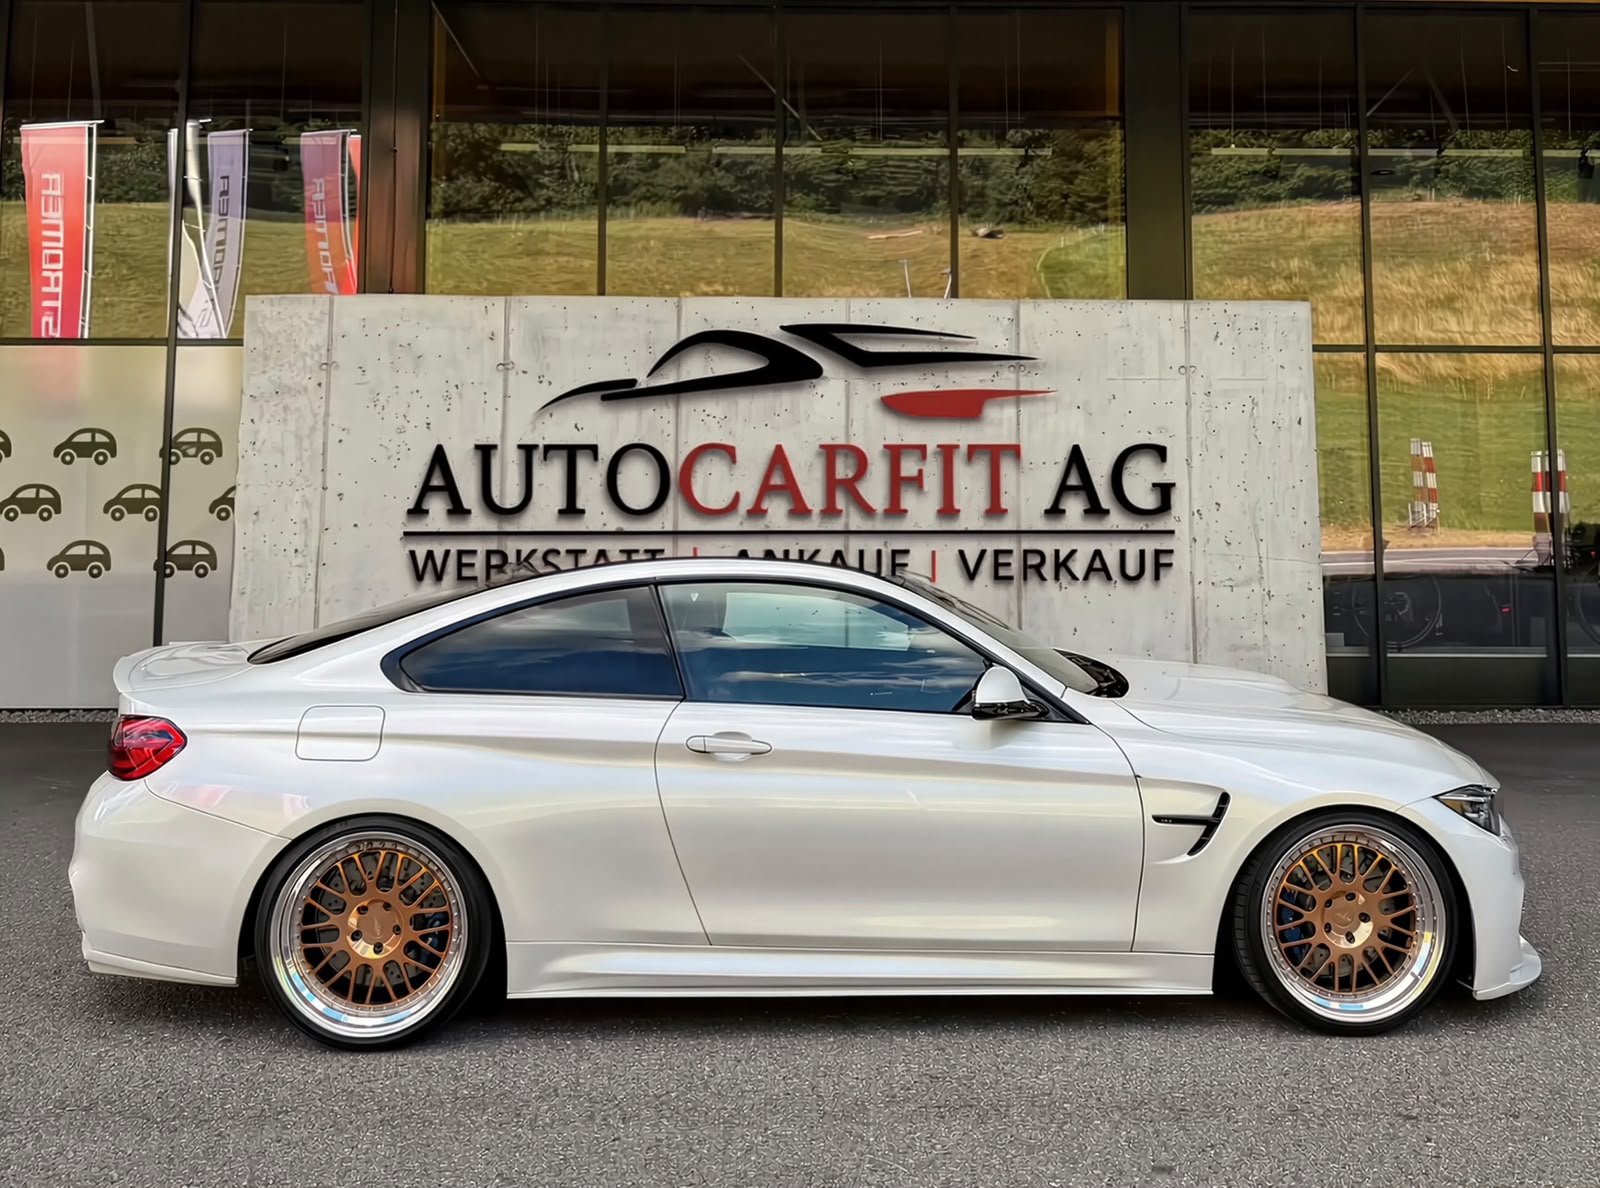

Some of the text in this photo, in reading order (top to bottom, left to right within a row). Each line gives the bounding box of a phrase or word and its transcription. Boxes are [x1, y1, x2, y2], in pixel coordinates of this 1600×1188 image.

[407, 443, 1176, 516] AUTOCARFIT AG
[958, 549, 1174, 582] VERKAUF
